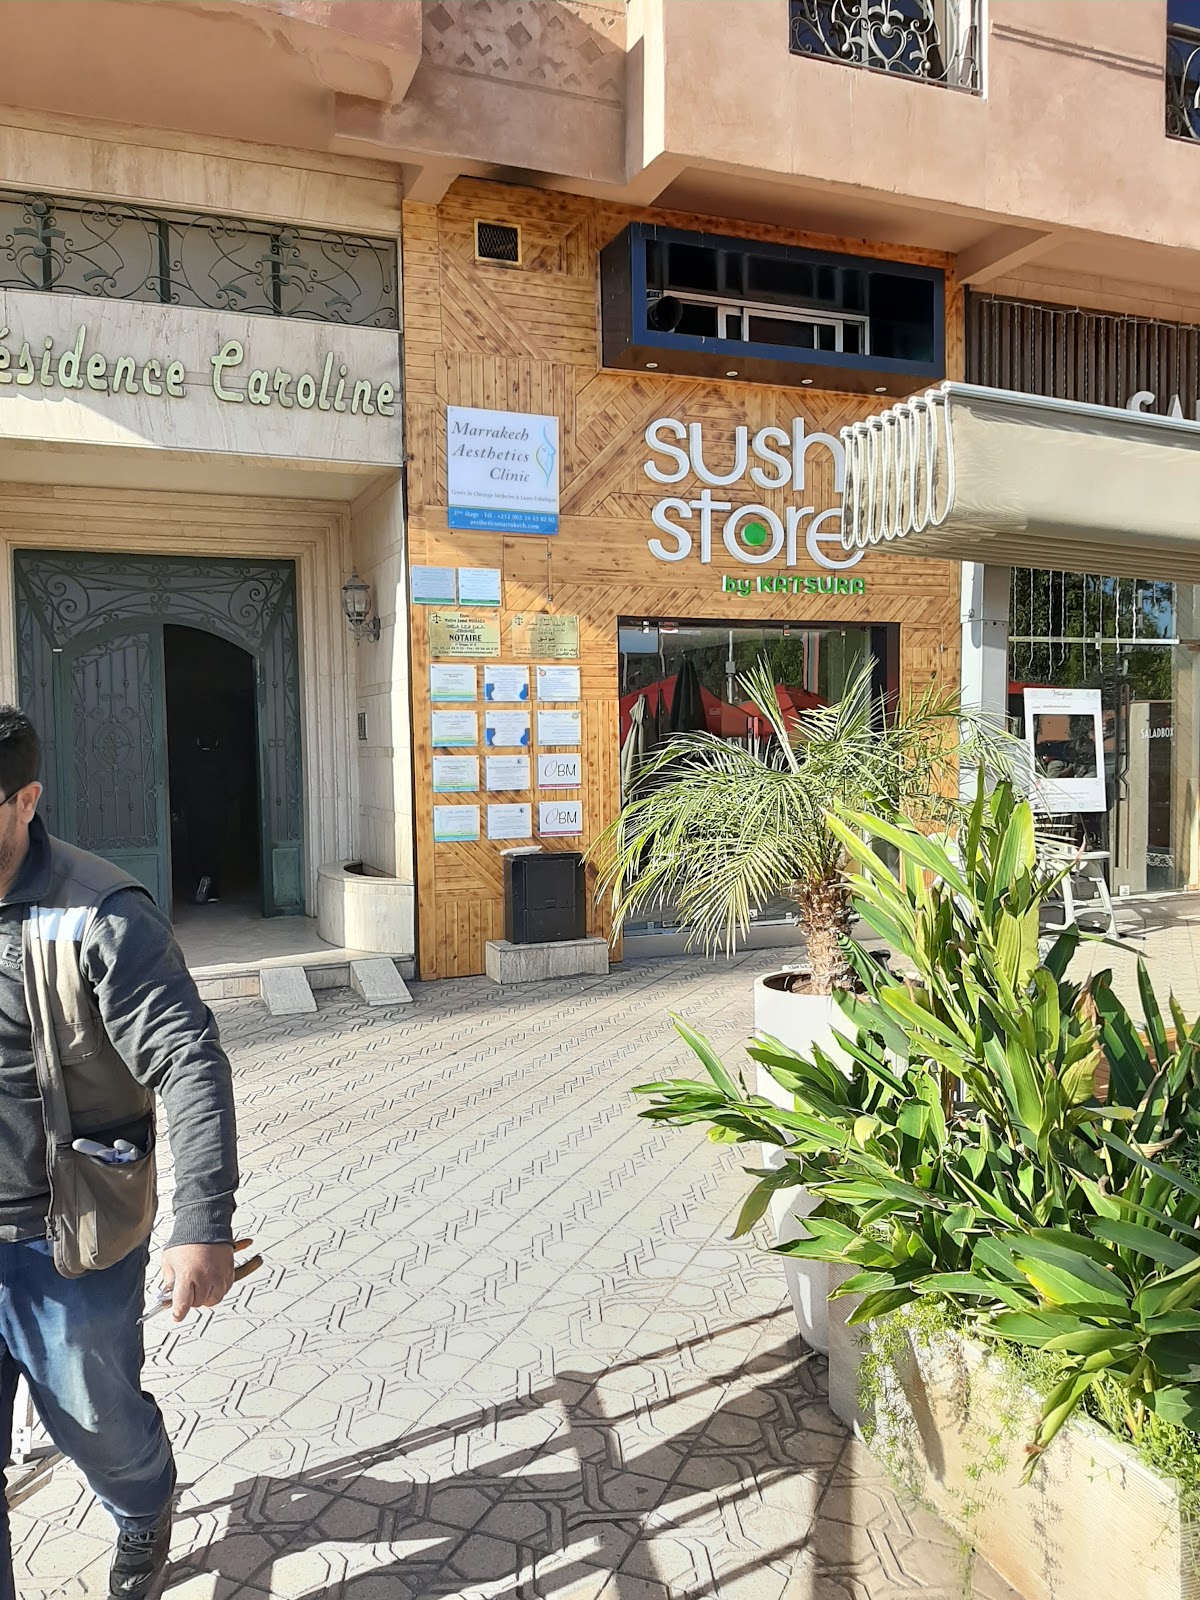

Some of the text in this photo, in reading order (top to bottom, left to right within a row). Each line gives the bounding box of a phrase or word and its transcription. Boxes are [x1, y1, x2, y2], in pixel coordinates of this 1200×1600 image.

[210, 340, 396, 416] Caroline
[451, 421, 530, 442] Marrakech
[451, 443, 530, 463] Aesthetics
[489, 467, 530, 483] Clinic
[647, 488, 865, 570] store
[722, 574, 866, 597] by KATSURA
[448, 634, 482, 642] NOTAIRE
[1140, 727, 1174, 739] SALADBOX
